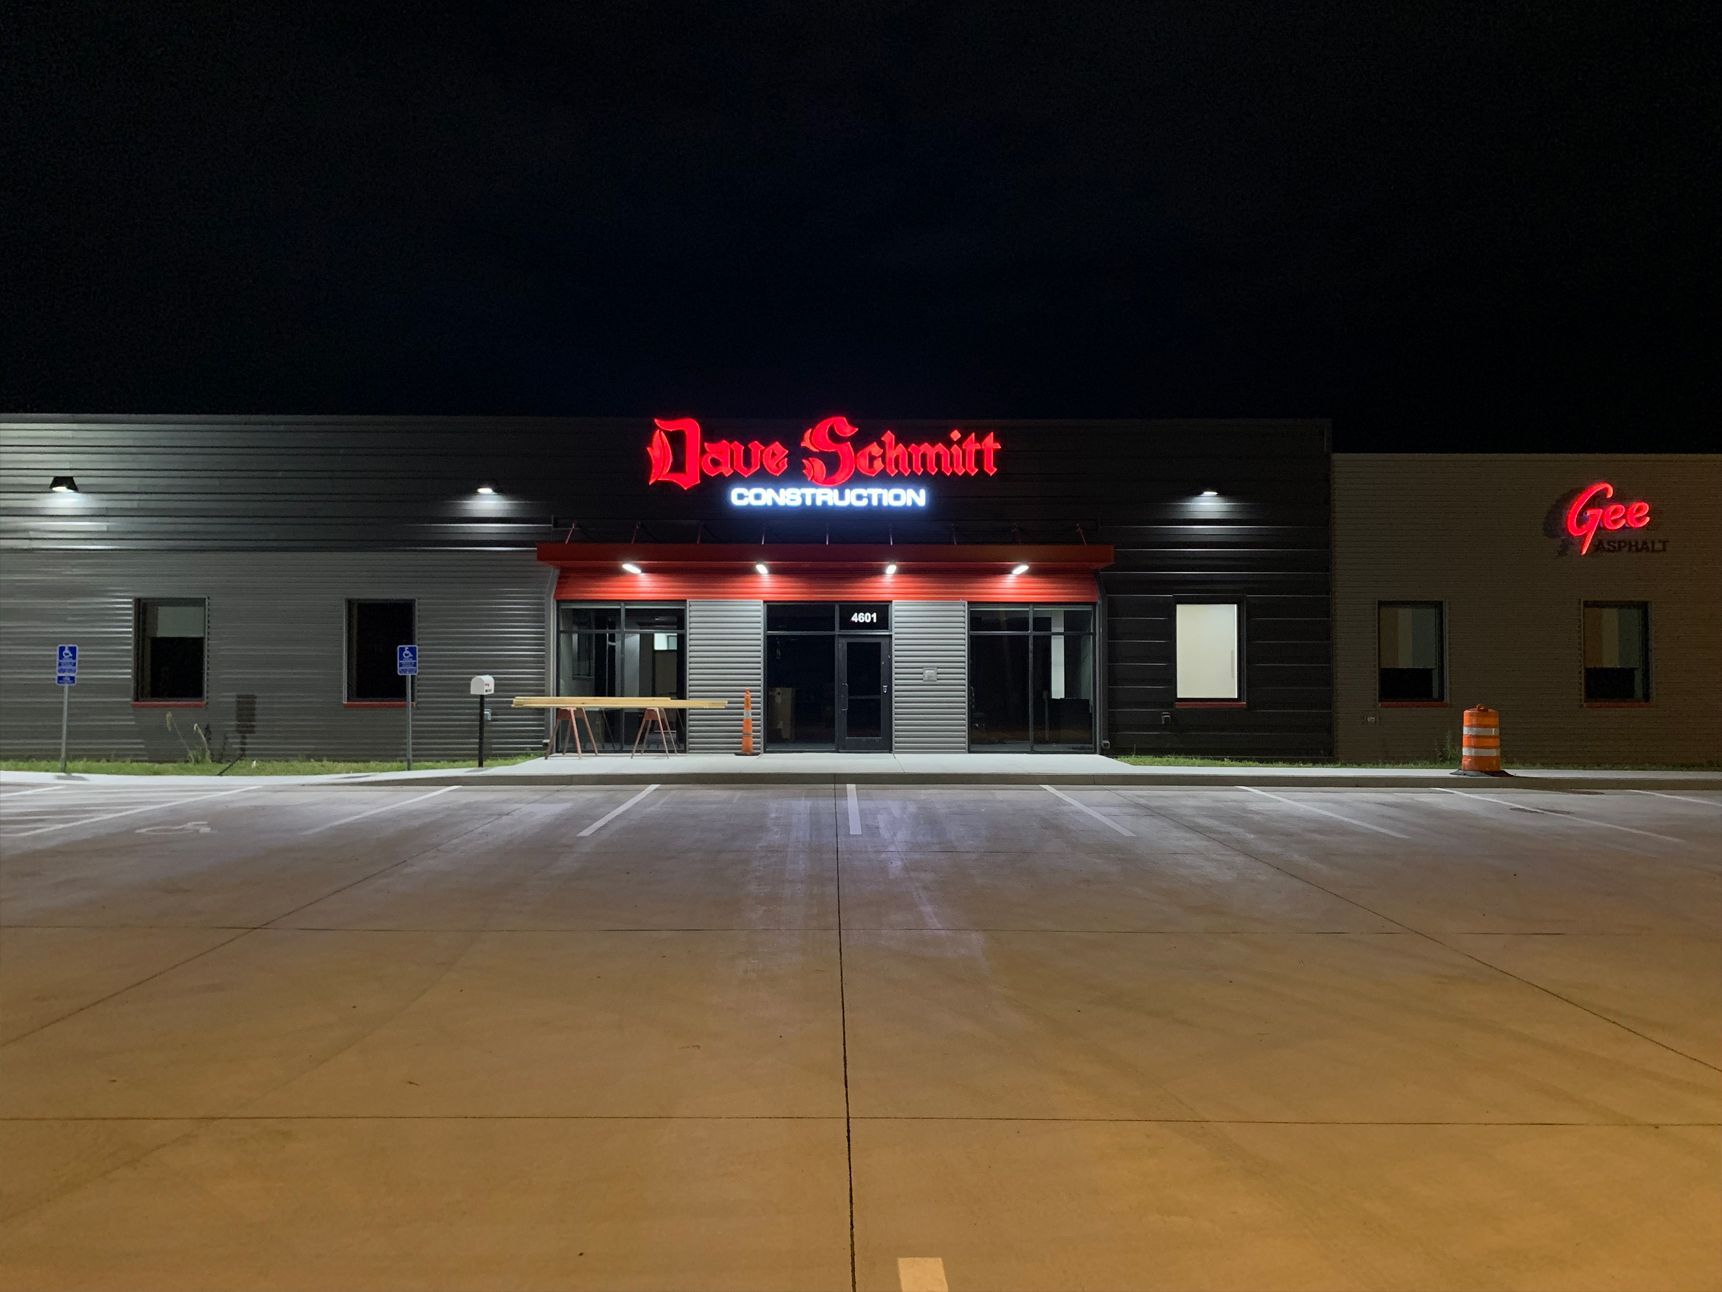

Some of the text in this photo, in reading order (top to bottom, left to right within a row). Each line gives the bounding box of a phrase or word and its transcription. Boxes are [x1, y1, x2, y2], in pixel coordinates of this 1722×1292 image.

[647, 416, 1002, 490] Dave Schmitt
[730, 487, 926, 507] CONSTRUCTION
[1567, 482, 1651, 556] Gee
[1596, 540, 1669, 553] ASPHALT
[851, 612, 877, 623] 4601
